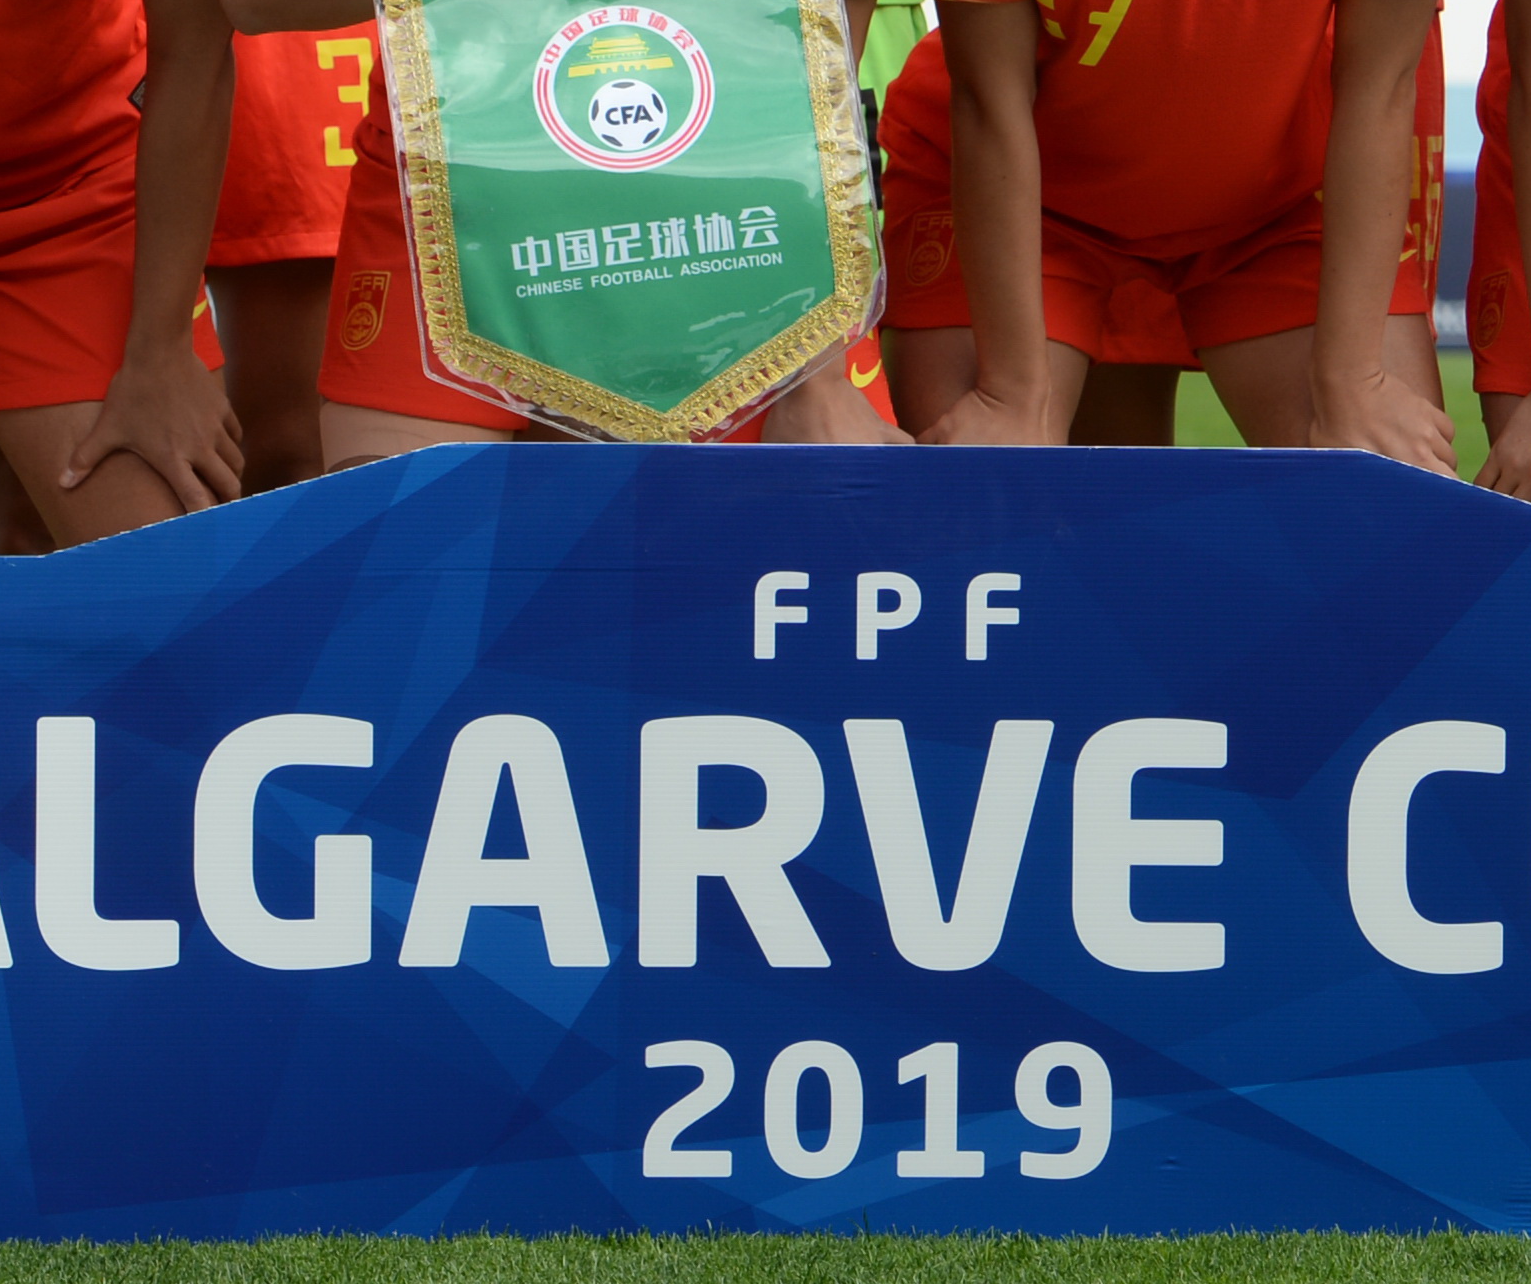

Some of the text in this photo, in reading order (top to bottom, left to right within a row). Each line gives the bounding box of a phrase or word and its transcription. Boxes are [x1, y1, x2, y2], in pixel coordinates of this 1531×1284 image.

[316, 37, 373, 167] 3
[604, 104, 654, 126] CFA
[510, 205, 780, 277] 中国足球协会
[516, 252, 783, 298] CHINESE FOOTBALL ASSOCIATION
[753, 570, 1023, 662] FPF
[642, 1039, 1114, 1180] 2019
